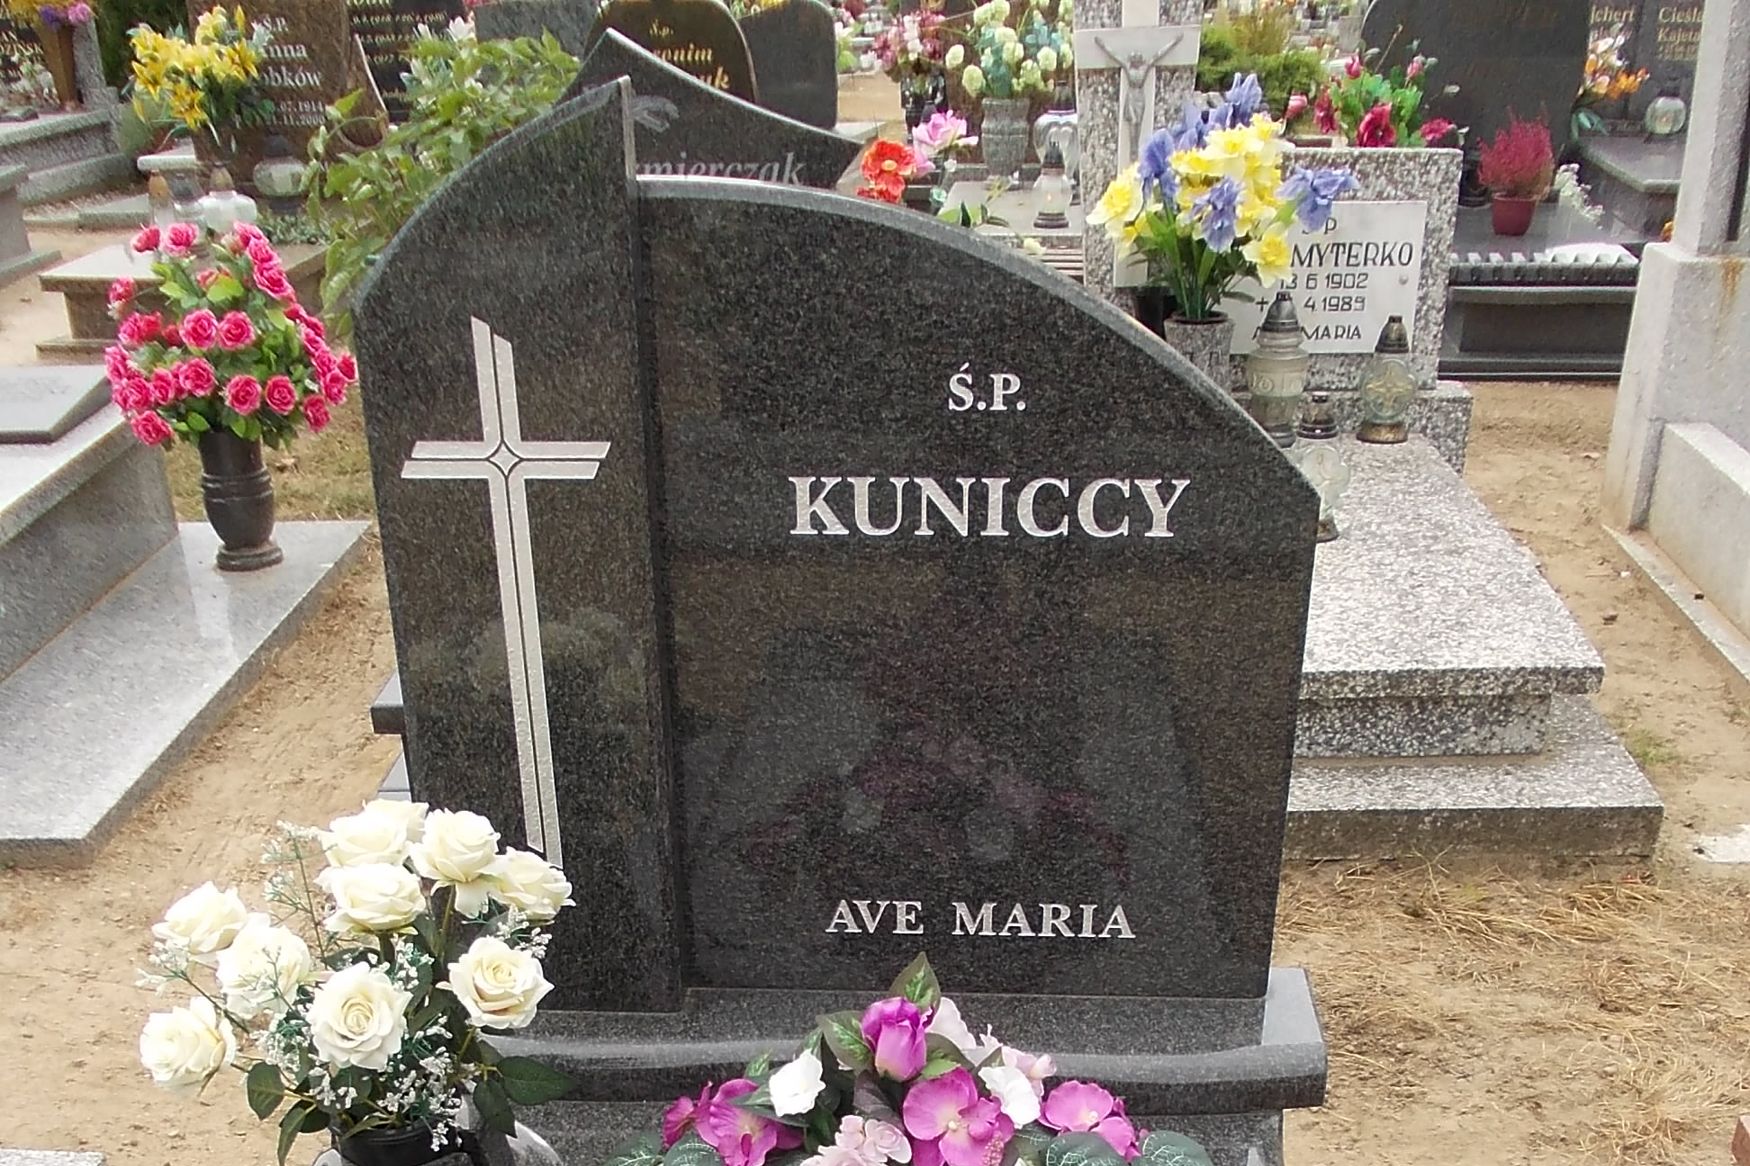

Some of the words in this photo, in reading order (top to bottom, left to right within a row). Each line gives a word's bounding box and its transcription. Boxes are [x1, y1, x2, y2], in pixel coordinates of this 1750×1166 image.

[636, 151, 807, 186] mierczak
[1290, 242, 1413, 268] MYTERKO
[1306, 273, 1318, 290] 6
[1325, 273, 1369, 290] 1902
[948, 362, 1027, 411] Ś.P.
[788, 476, 1191, 537] KUNICCY
[825, 899, 925, 935] AVE
[951, 901, 1136, 939] MARIA
